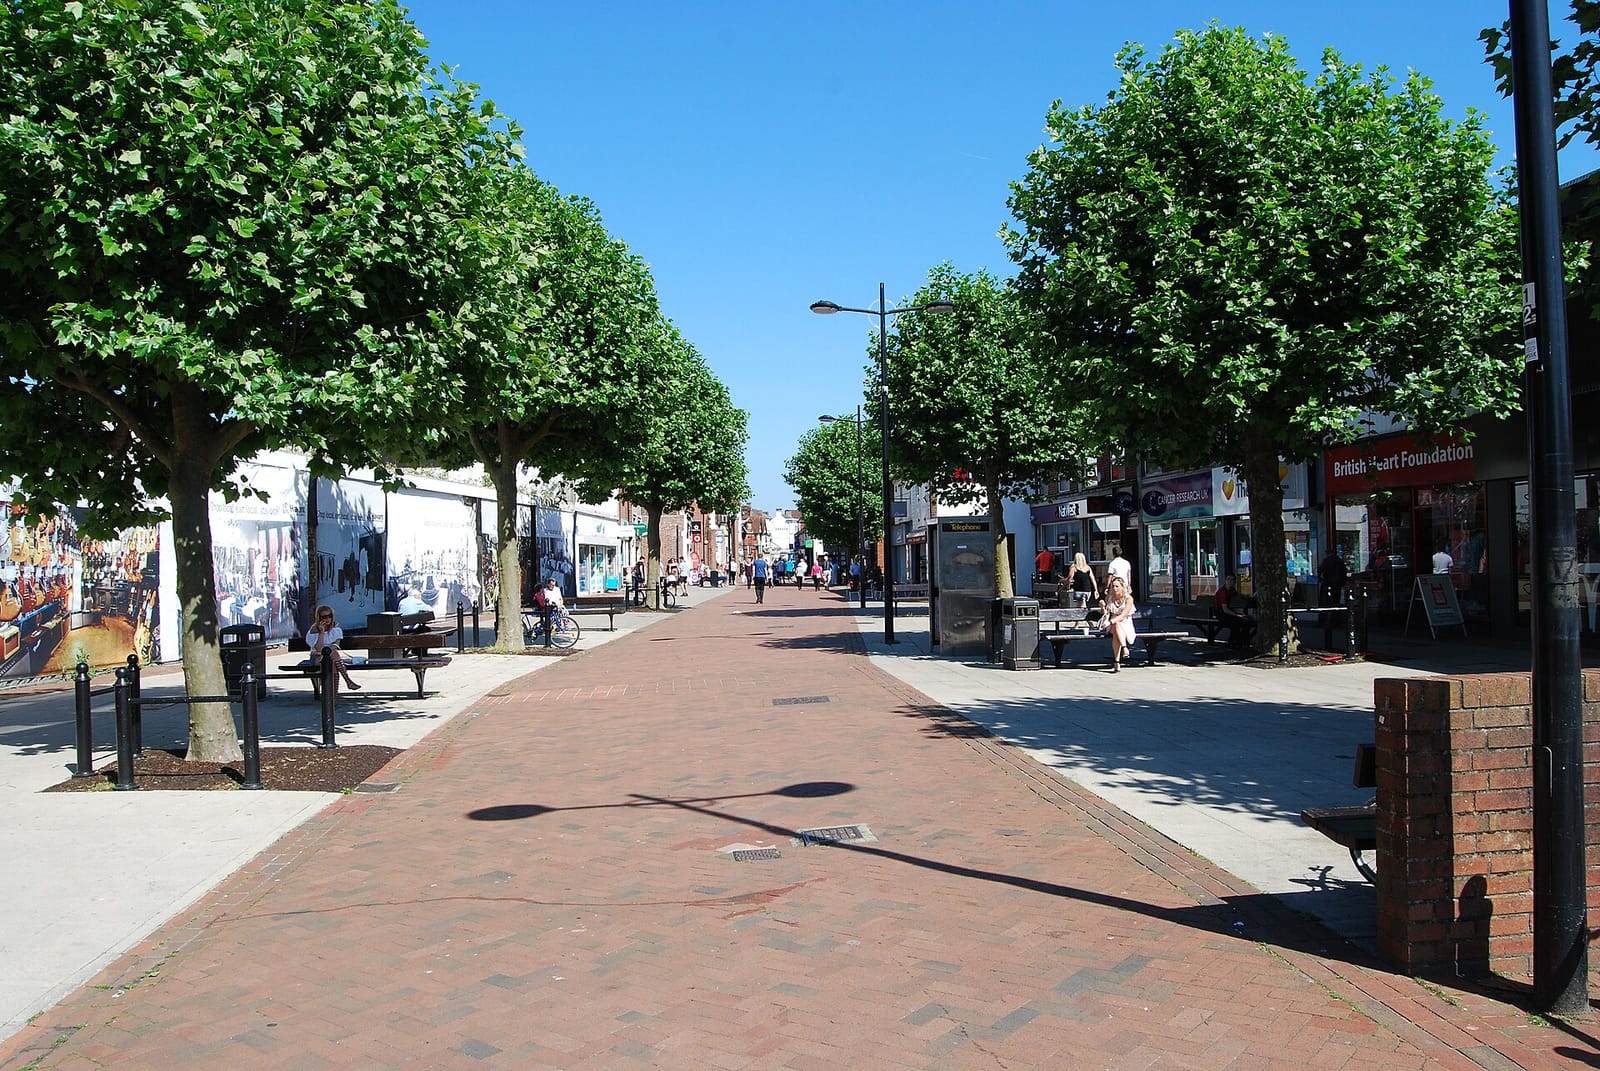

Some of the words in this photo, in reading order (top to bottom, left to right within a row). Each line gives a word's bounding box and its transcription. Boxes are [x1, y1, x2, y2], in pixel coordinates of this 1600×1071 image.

[1334, 459, 1366, 477] British
[1401, 443, 1474, 468] Foundation
[1157, 494, 1176, 505] CANCER
[1176, 490, 1200, 502] RESEARCH
[950, 523, 982, 531] Telephone
